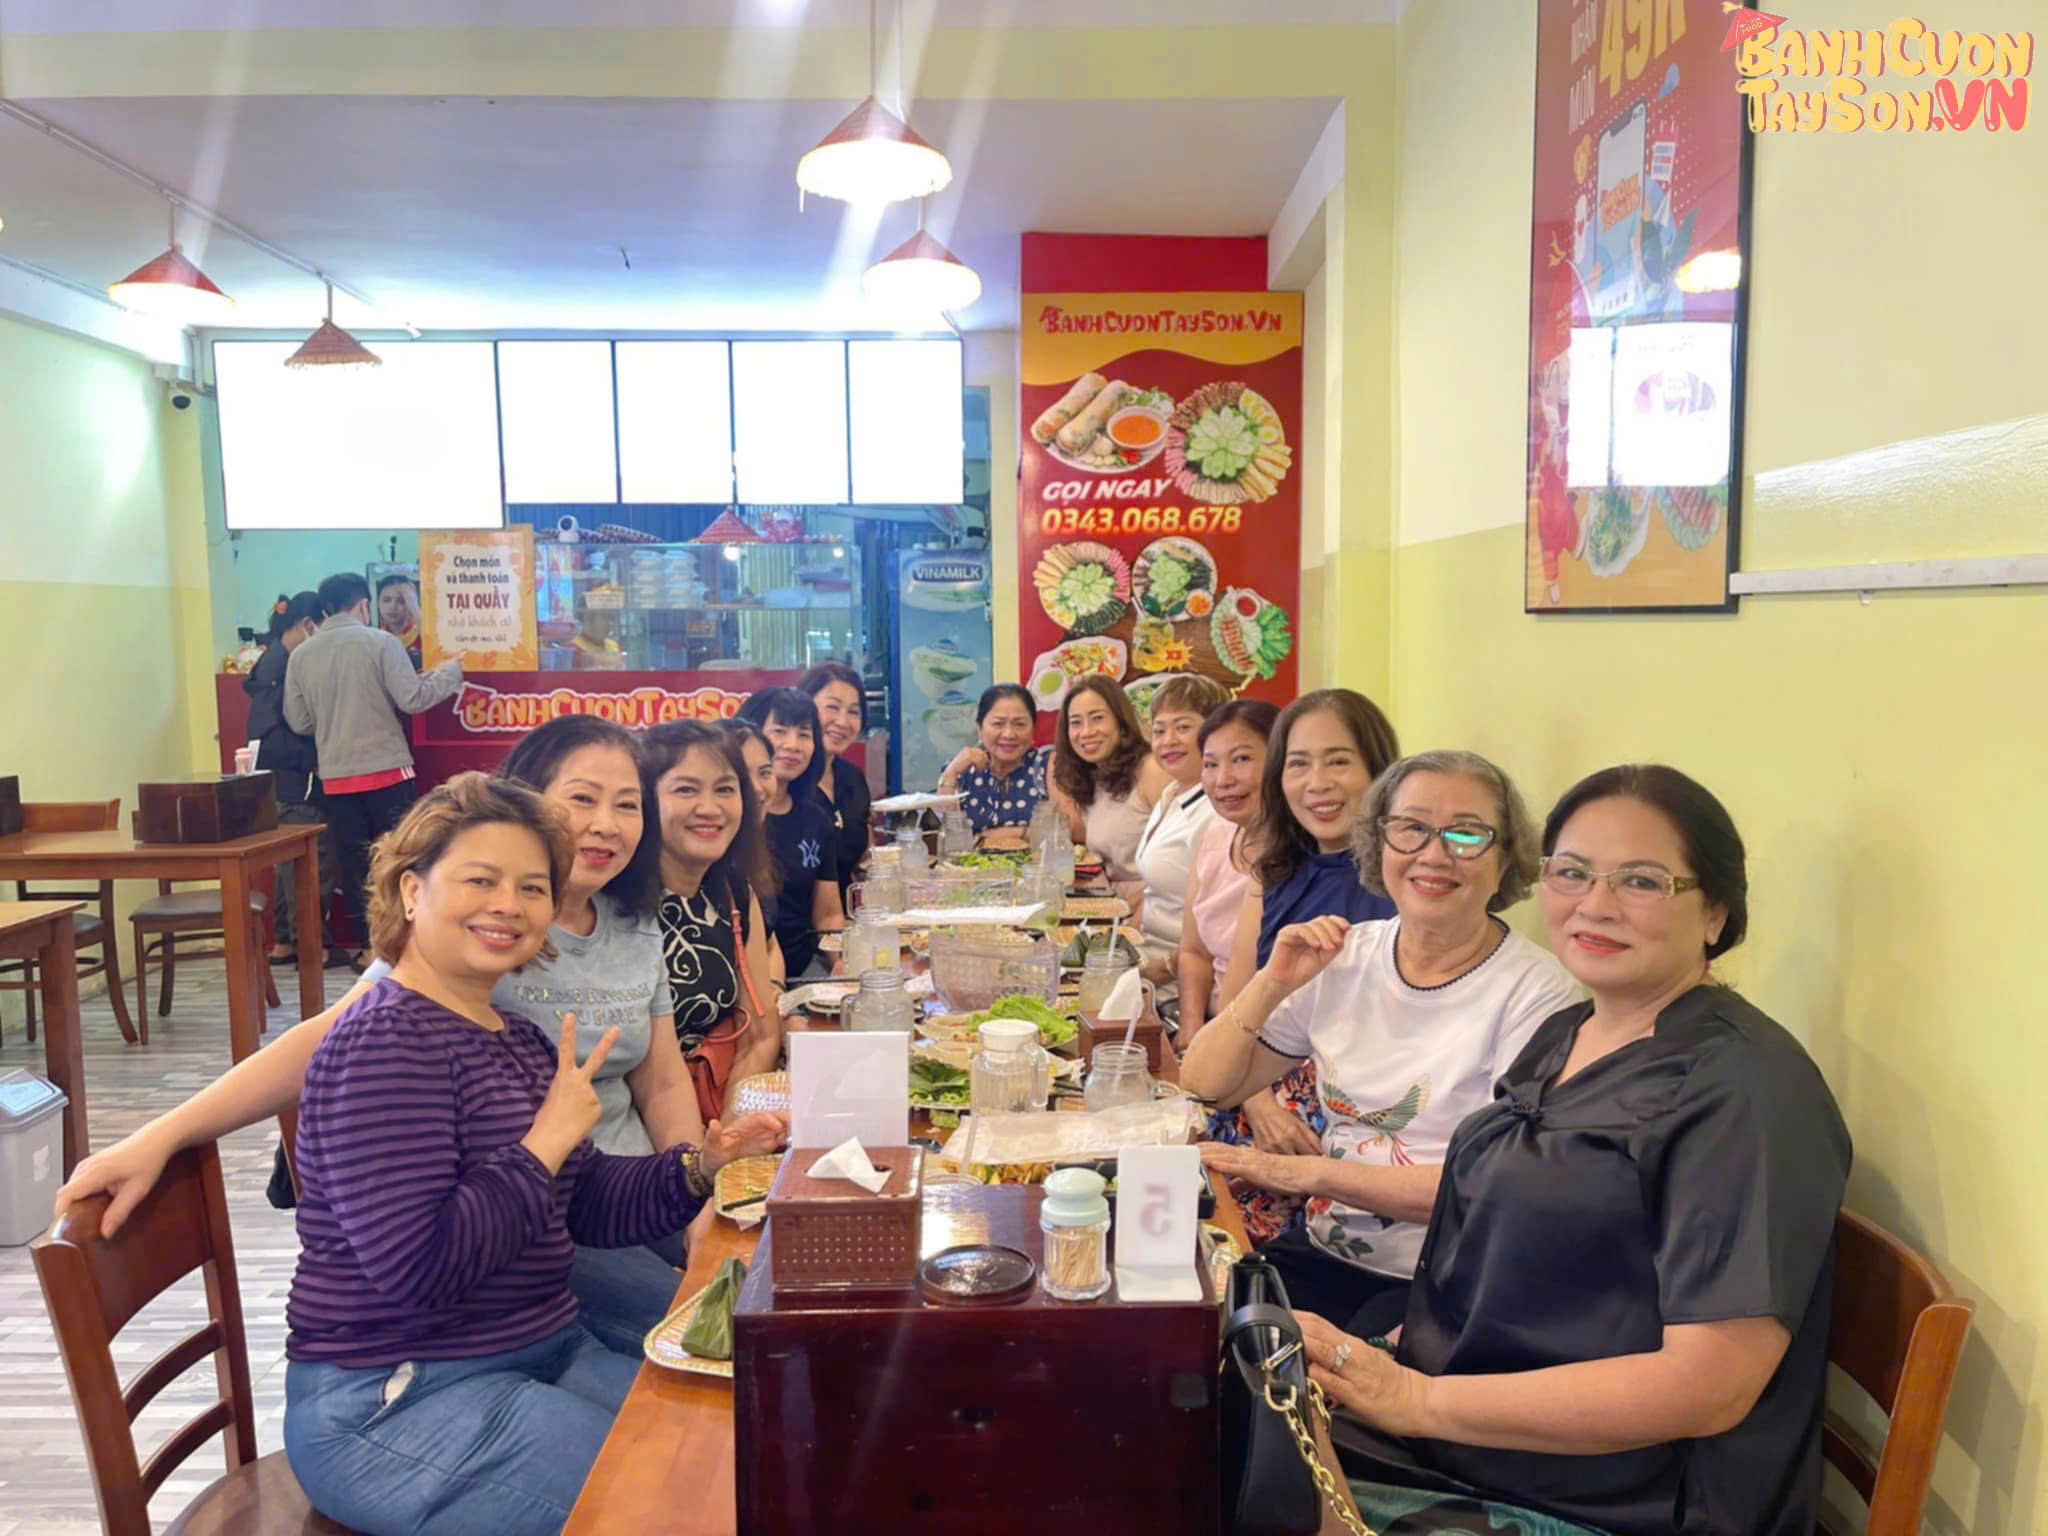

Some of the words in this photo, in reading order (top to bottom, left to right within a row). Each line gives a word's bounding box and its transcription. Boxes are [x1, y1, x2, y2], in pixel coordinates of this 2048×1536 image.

[1042, 480, 1092, 506] GỌI
[1094, 479, 1172, 499] NGAY
[1041, 506, 1243, 535] 0343.068.678
[454, 555, 478, 570] Chọn
[480, 554, 501, 568] món
[916, 566, 982, 580] VINAMILK
[446, 571, 457, 584] và
[459, 572, 486, 584] thanh
[488, 571, 510, 584] toán
[446, 592, 470, 614] TẠI
[464, 688, 749, 727] BANHCUONTAYSO
